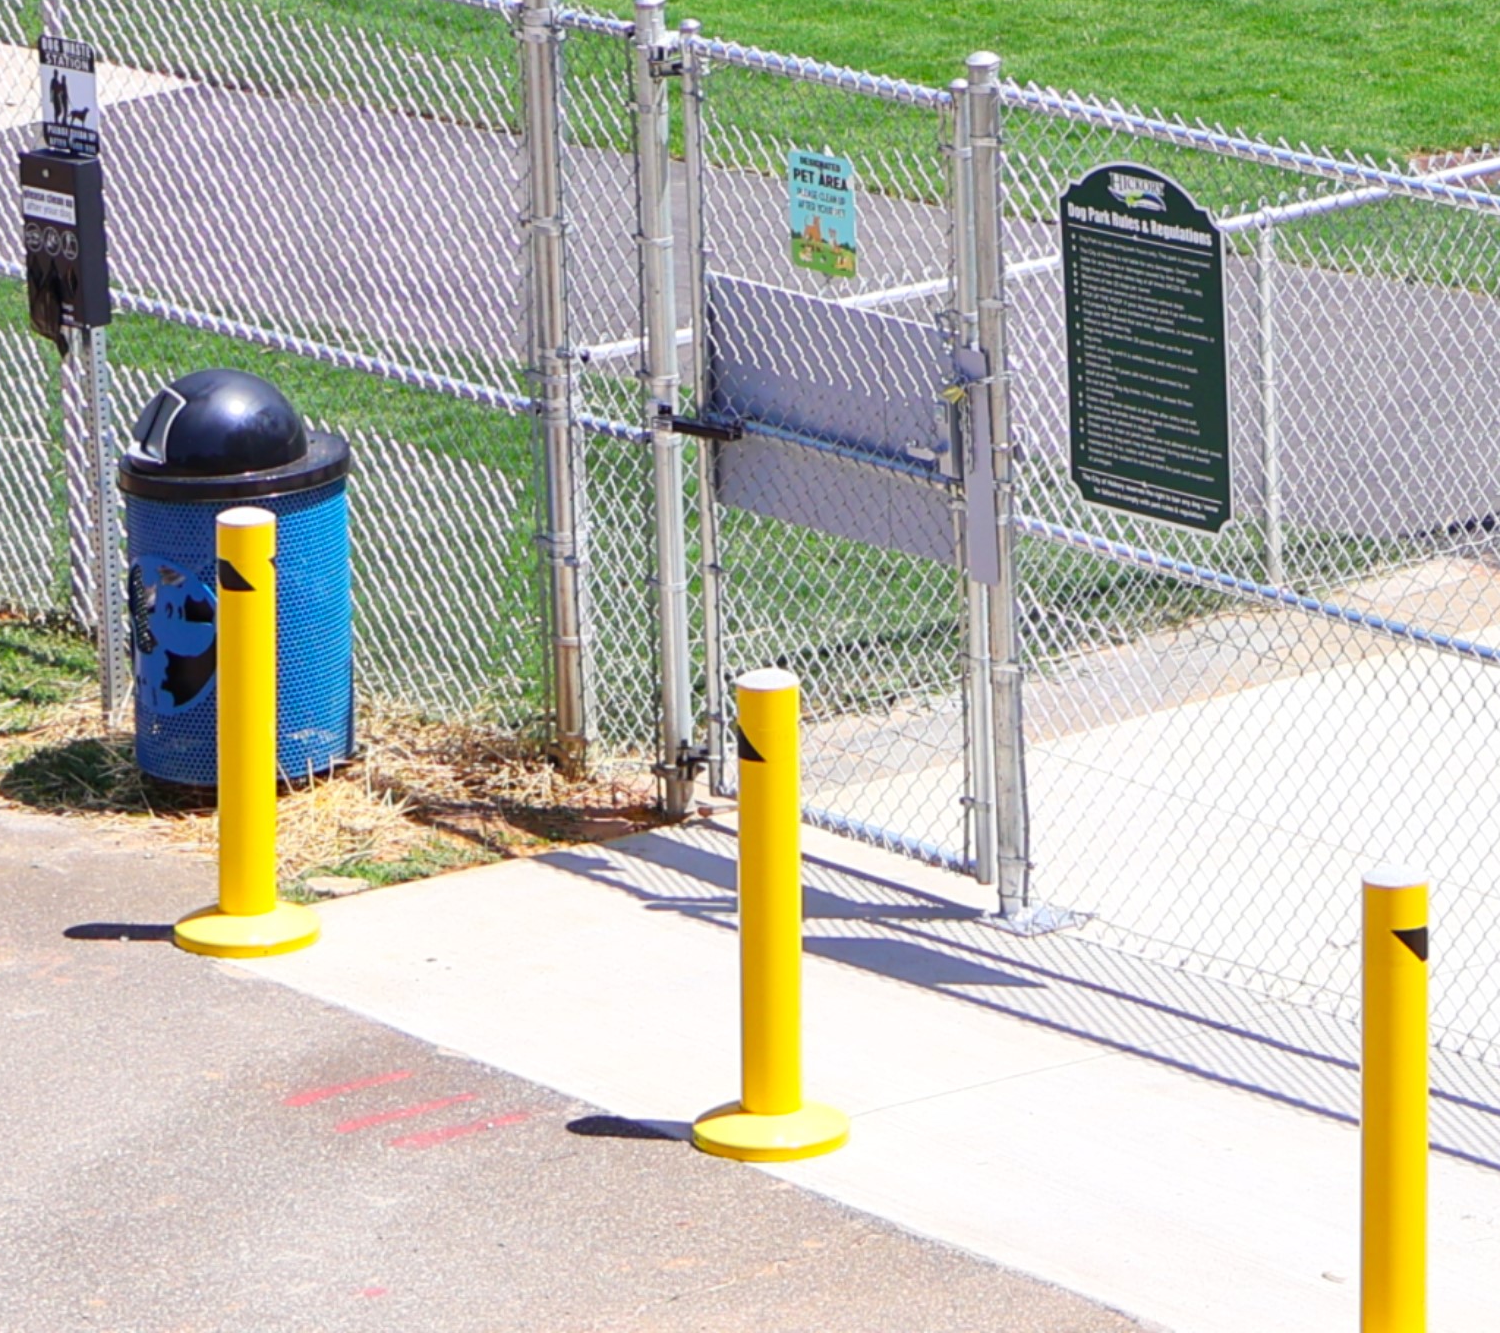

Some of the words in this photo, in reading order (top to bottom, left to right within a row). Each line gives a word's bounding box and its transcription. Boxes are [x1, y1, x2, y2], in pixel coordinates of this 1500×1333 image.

[41, 36, 59, 52] DOG
[62, 41, 90, 58] WASTE
[45, 53, 89, 72] STATION
[793, 167, 814, 184] PET
[819, 172, 848, 191] AREA
[1108, 171, 1165, 196] HICKORY
[1067, 201, 1087, 222] Dog
[1088, 206, 1111, 226] Park
[1111, 211, 1140, 232] Rules
[1141, 219, 1149, 233] &
[1150, 219, 1213, 247] Regulations
